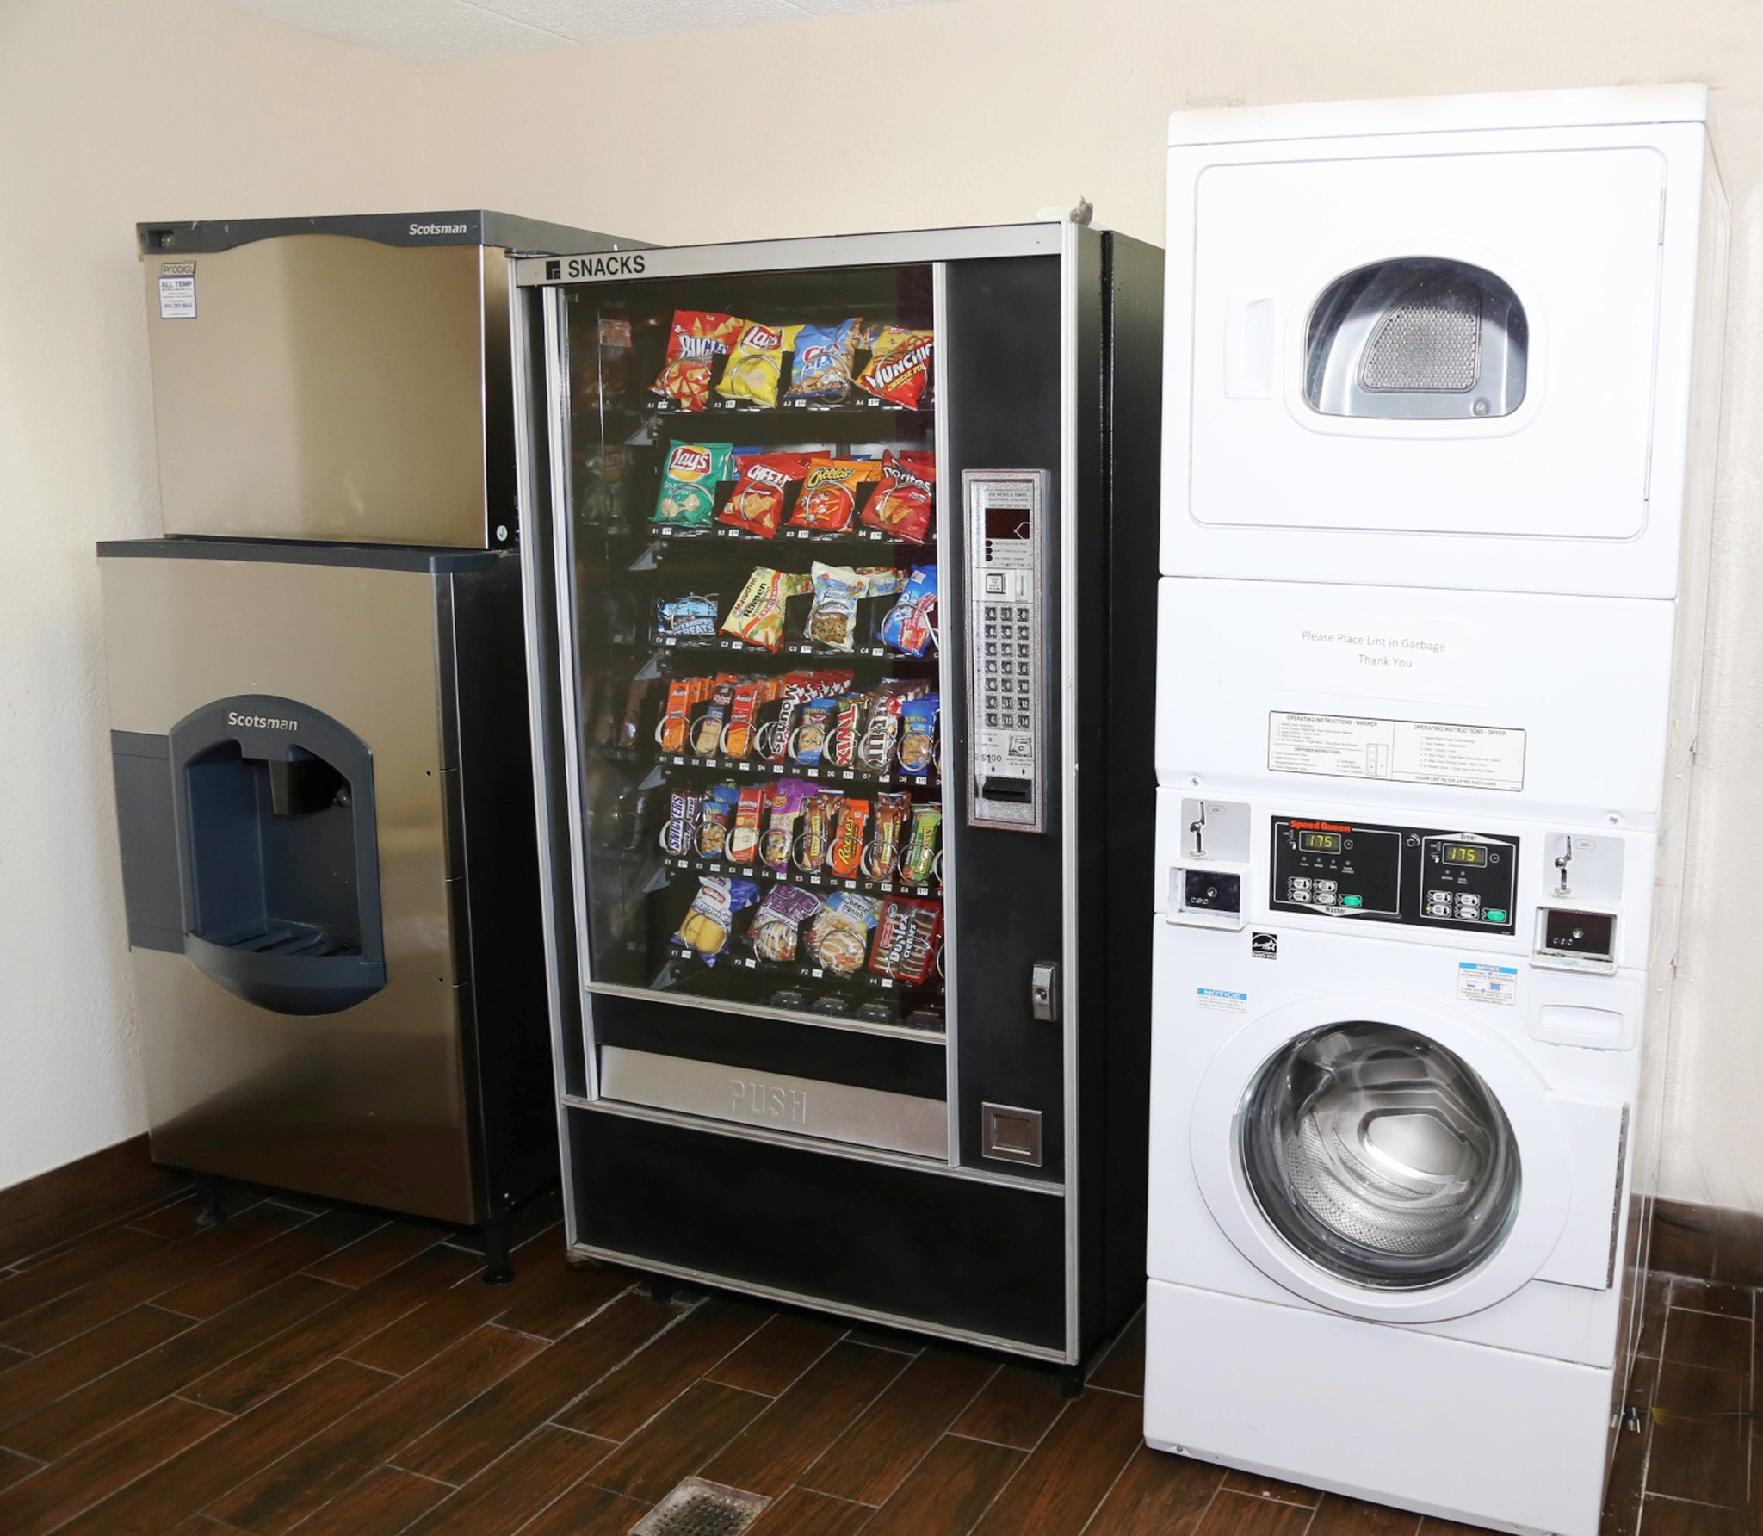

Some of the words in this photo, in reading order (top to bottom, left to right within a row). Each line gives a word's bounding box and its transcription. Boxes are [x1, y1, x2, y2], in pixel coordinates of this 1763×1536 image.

[409, 223, 468, 236] Scotsman
[568, 255, 646, 278] SNACKS
[1301, 630, 1334, 642] Please
[1337, 634, 1364, 645] Place
[1367, 635, 1386, 647] Lint
[1389, 637, 1398, 648] in
[1401, 638, 1446, 653] Garbage
[1358, 654, 1390, 666] Thank
[1393, 657, 1412, 668] You
[228, 711, 298, 731] Scotsman
[669, 794, 684, 852] SNICKERS
[1290, 820, 1320, 831] Speed
[1321, 822, 1352, 832] Queen
[1309, 835, 1333, 848] 175
[1451, 848, 1476, 861] 175
[730, 1080, 807, 1124] PUSH
